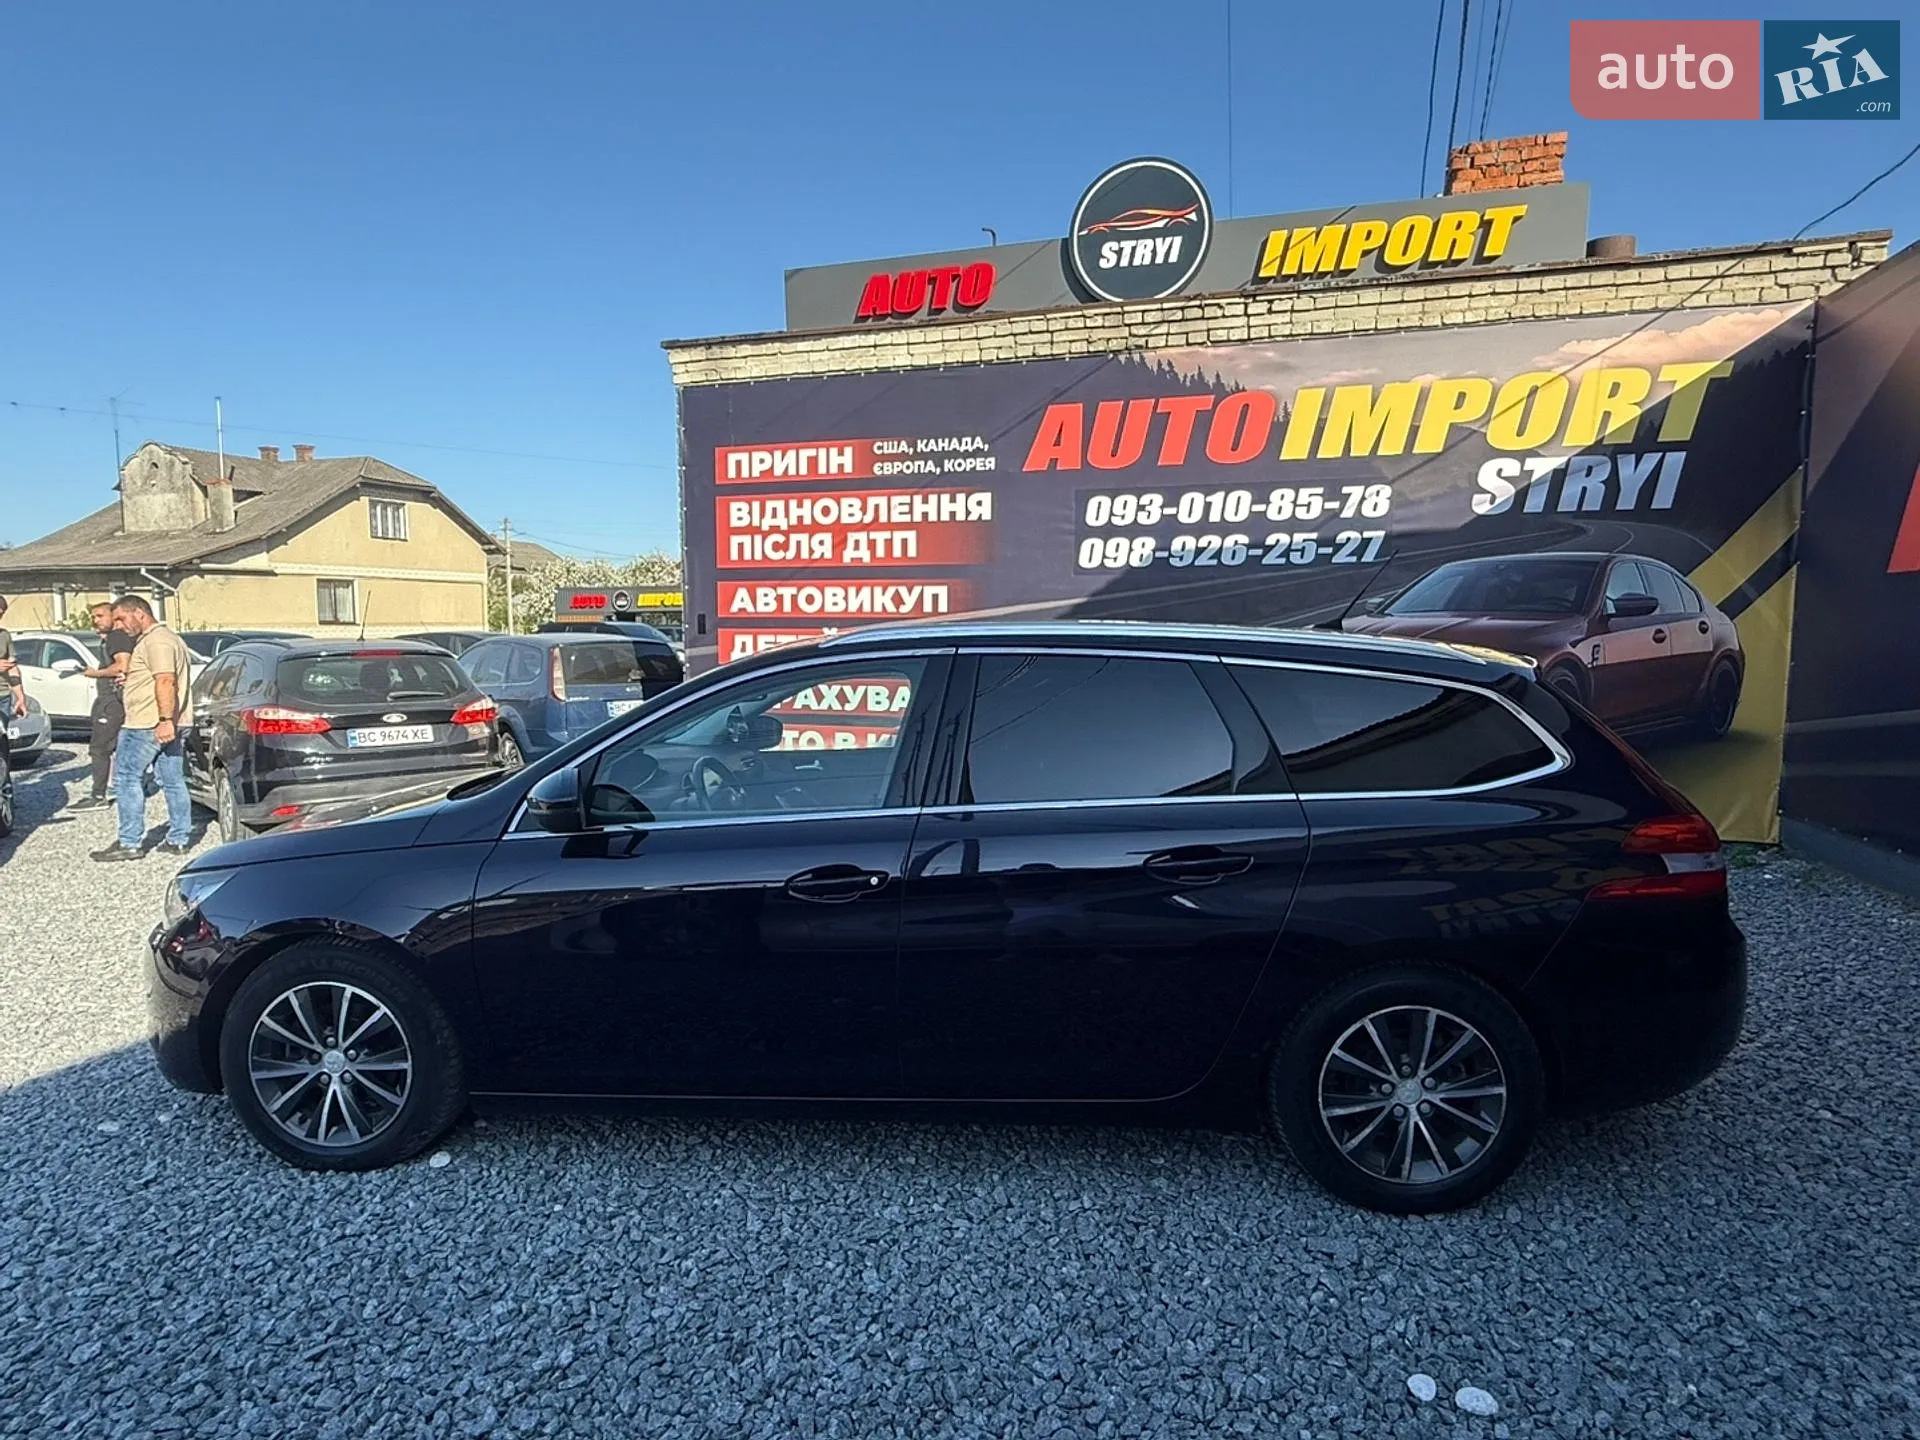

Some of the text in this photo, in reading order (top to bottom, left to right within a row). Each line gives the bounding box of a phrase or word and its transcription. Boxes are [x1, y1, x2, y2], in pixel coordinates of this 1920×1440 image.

[1099, 236, 1184, 270] STRYI
[1258, 203, 1529, 278] IMPORT
[856, 262, 996, 320] AUTO
[727, 446, 854, 479] ПРИГІН
[873, 436, 989, 456] США, КАНАДА,
[873, 456, 996, 476] ЄВРОПА, КОРЕЯ
[1470, 450, 1687, 516] STRYI
[729, 492, 993, 531] ВІДНОВЛЕННЯ
[1084, 484, 1393, 527] 093-010-85-78
[729, 530, 917, 563] ПІСЛЯ ДТП
[1077, 530, 1386, 570] 098-926-25-27
[730, 584, 949, 614] АВТОВИКУП
[379, 729, 409, 742] 9674
